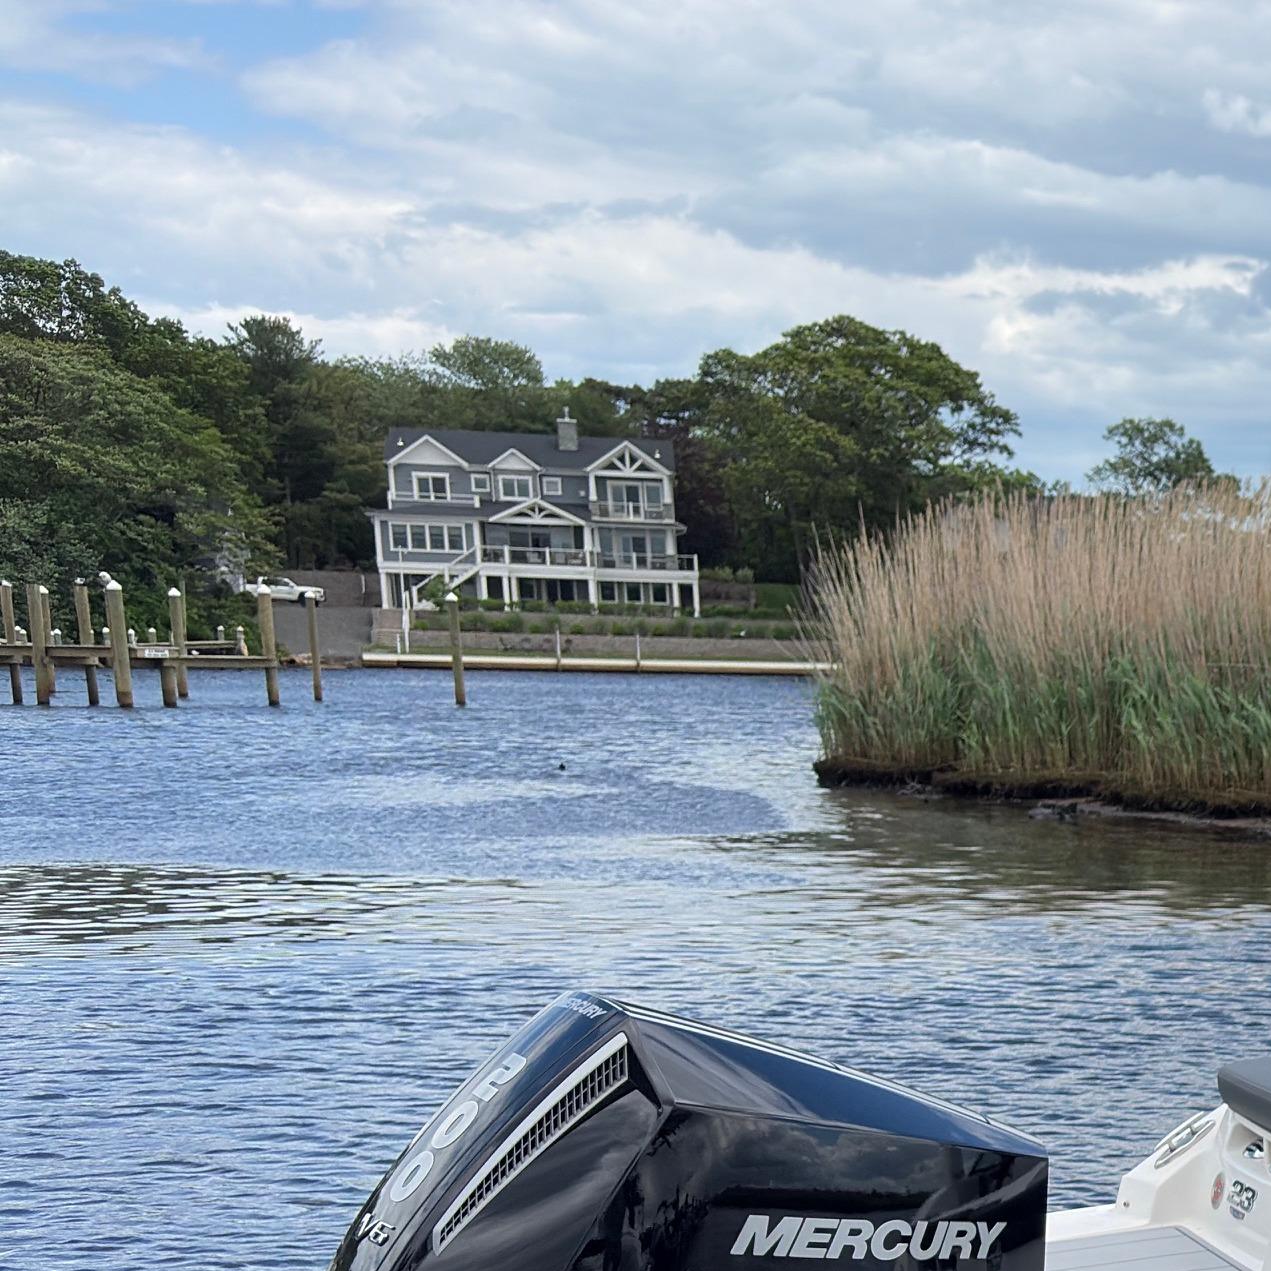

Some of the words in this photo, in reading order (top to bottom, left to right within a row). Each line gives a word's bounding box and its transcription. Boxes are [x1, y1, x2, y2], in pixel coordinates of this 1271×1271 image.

[390, 1053, 527, 1203] 200
[1227, 1180, 1258, 1213] 23
[357, 1212, 396, 1246] V6
[729, 1214, 1008, 1261] MERCURY
